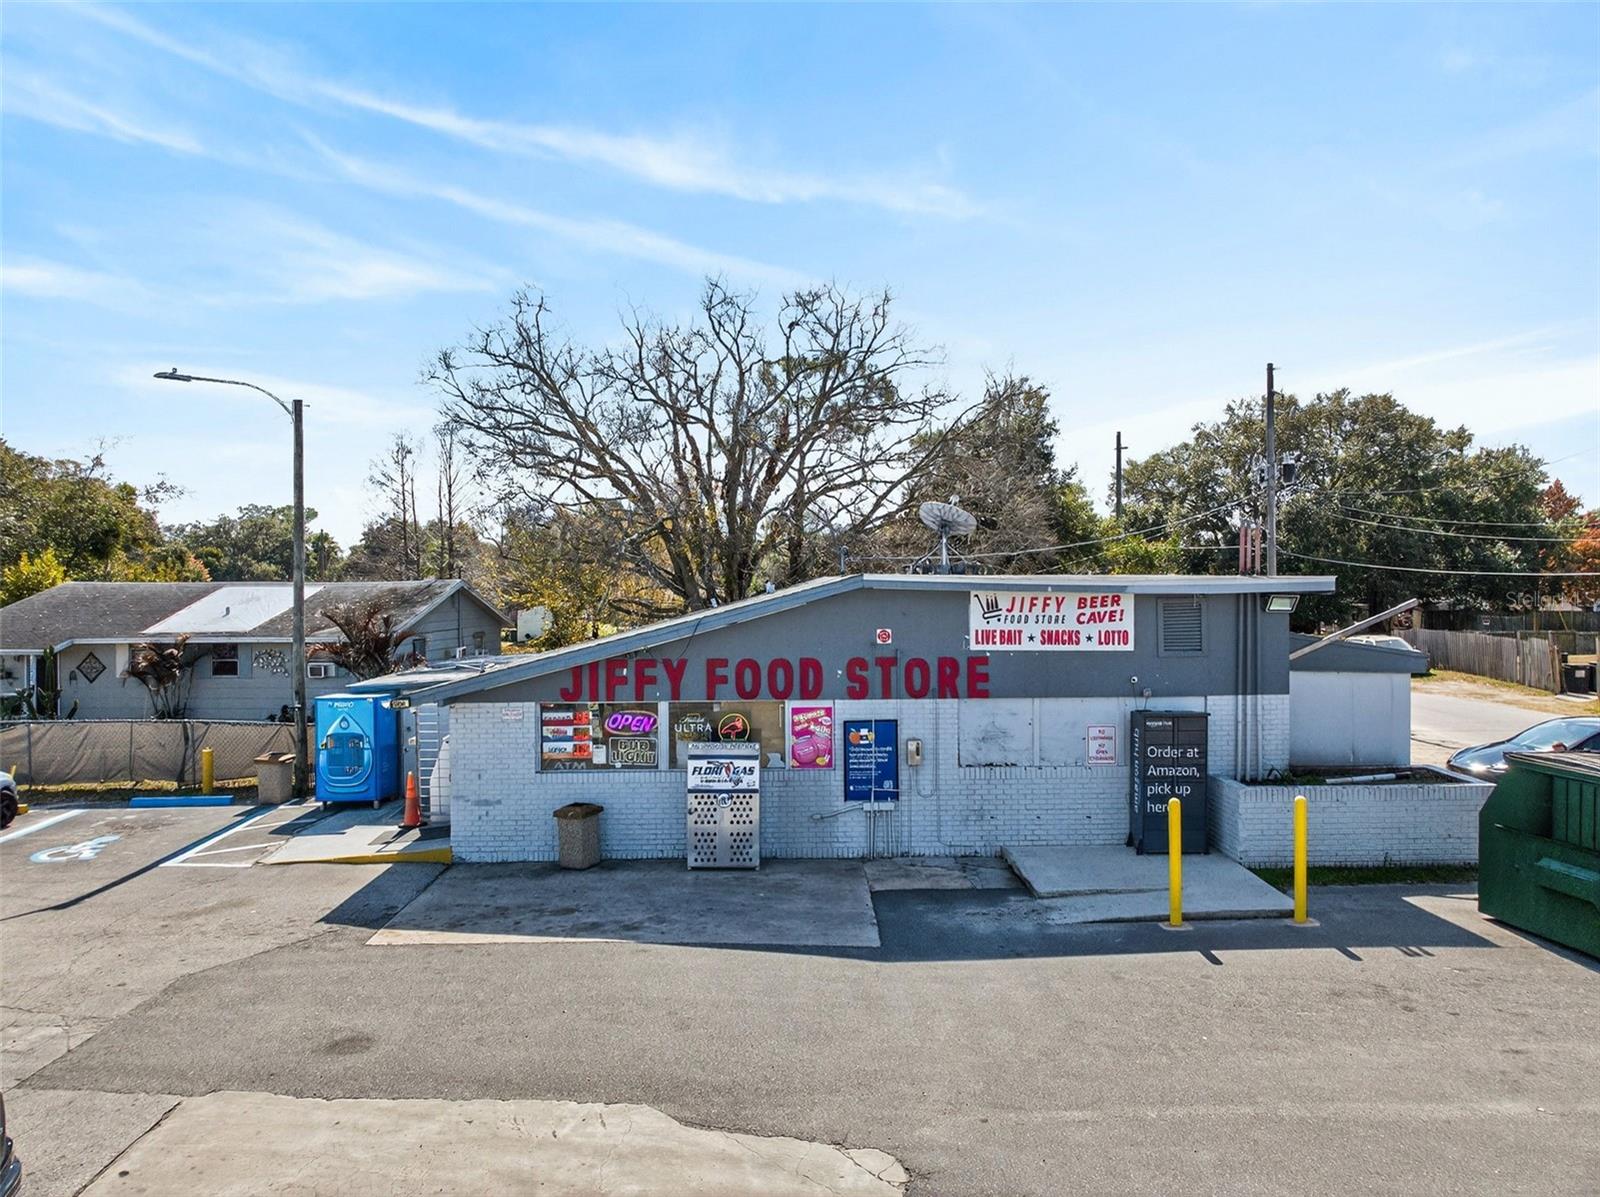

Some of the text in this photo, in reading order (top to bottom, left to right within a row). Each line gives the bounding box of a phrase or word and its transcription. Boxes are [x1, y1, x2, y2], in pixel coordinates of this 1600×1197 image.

[1006, 596, 1065, 613] JIFFY
[1077, 595, 1121, 609] BEER
[1004, 615, 1066, 625] FOOD STORE
[1077, 610, 1125, 624] CAVE!
[975, 630, 1130, 645] LIVE BAIT SNACKS LOTTO
[560, 656, 991, 702] JIFFY FOOD STORE
[608, 714, 654, 733] OPEN
[674, 723, 713, 733] ULTRA
[618, 739, 650, 751] BUD
[1147, 745, 1199, 758] Order at
[611, 750, 655, 763] LIGHT
[554, 761, 587, 770] ATM
[1147, 764, 1200, 778] Amazon,
[1147, 782, 1191, 797] pick up
